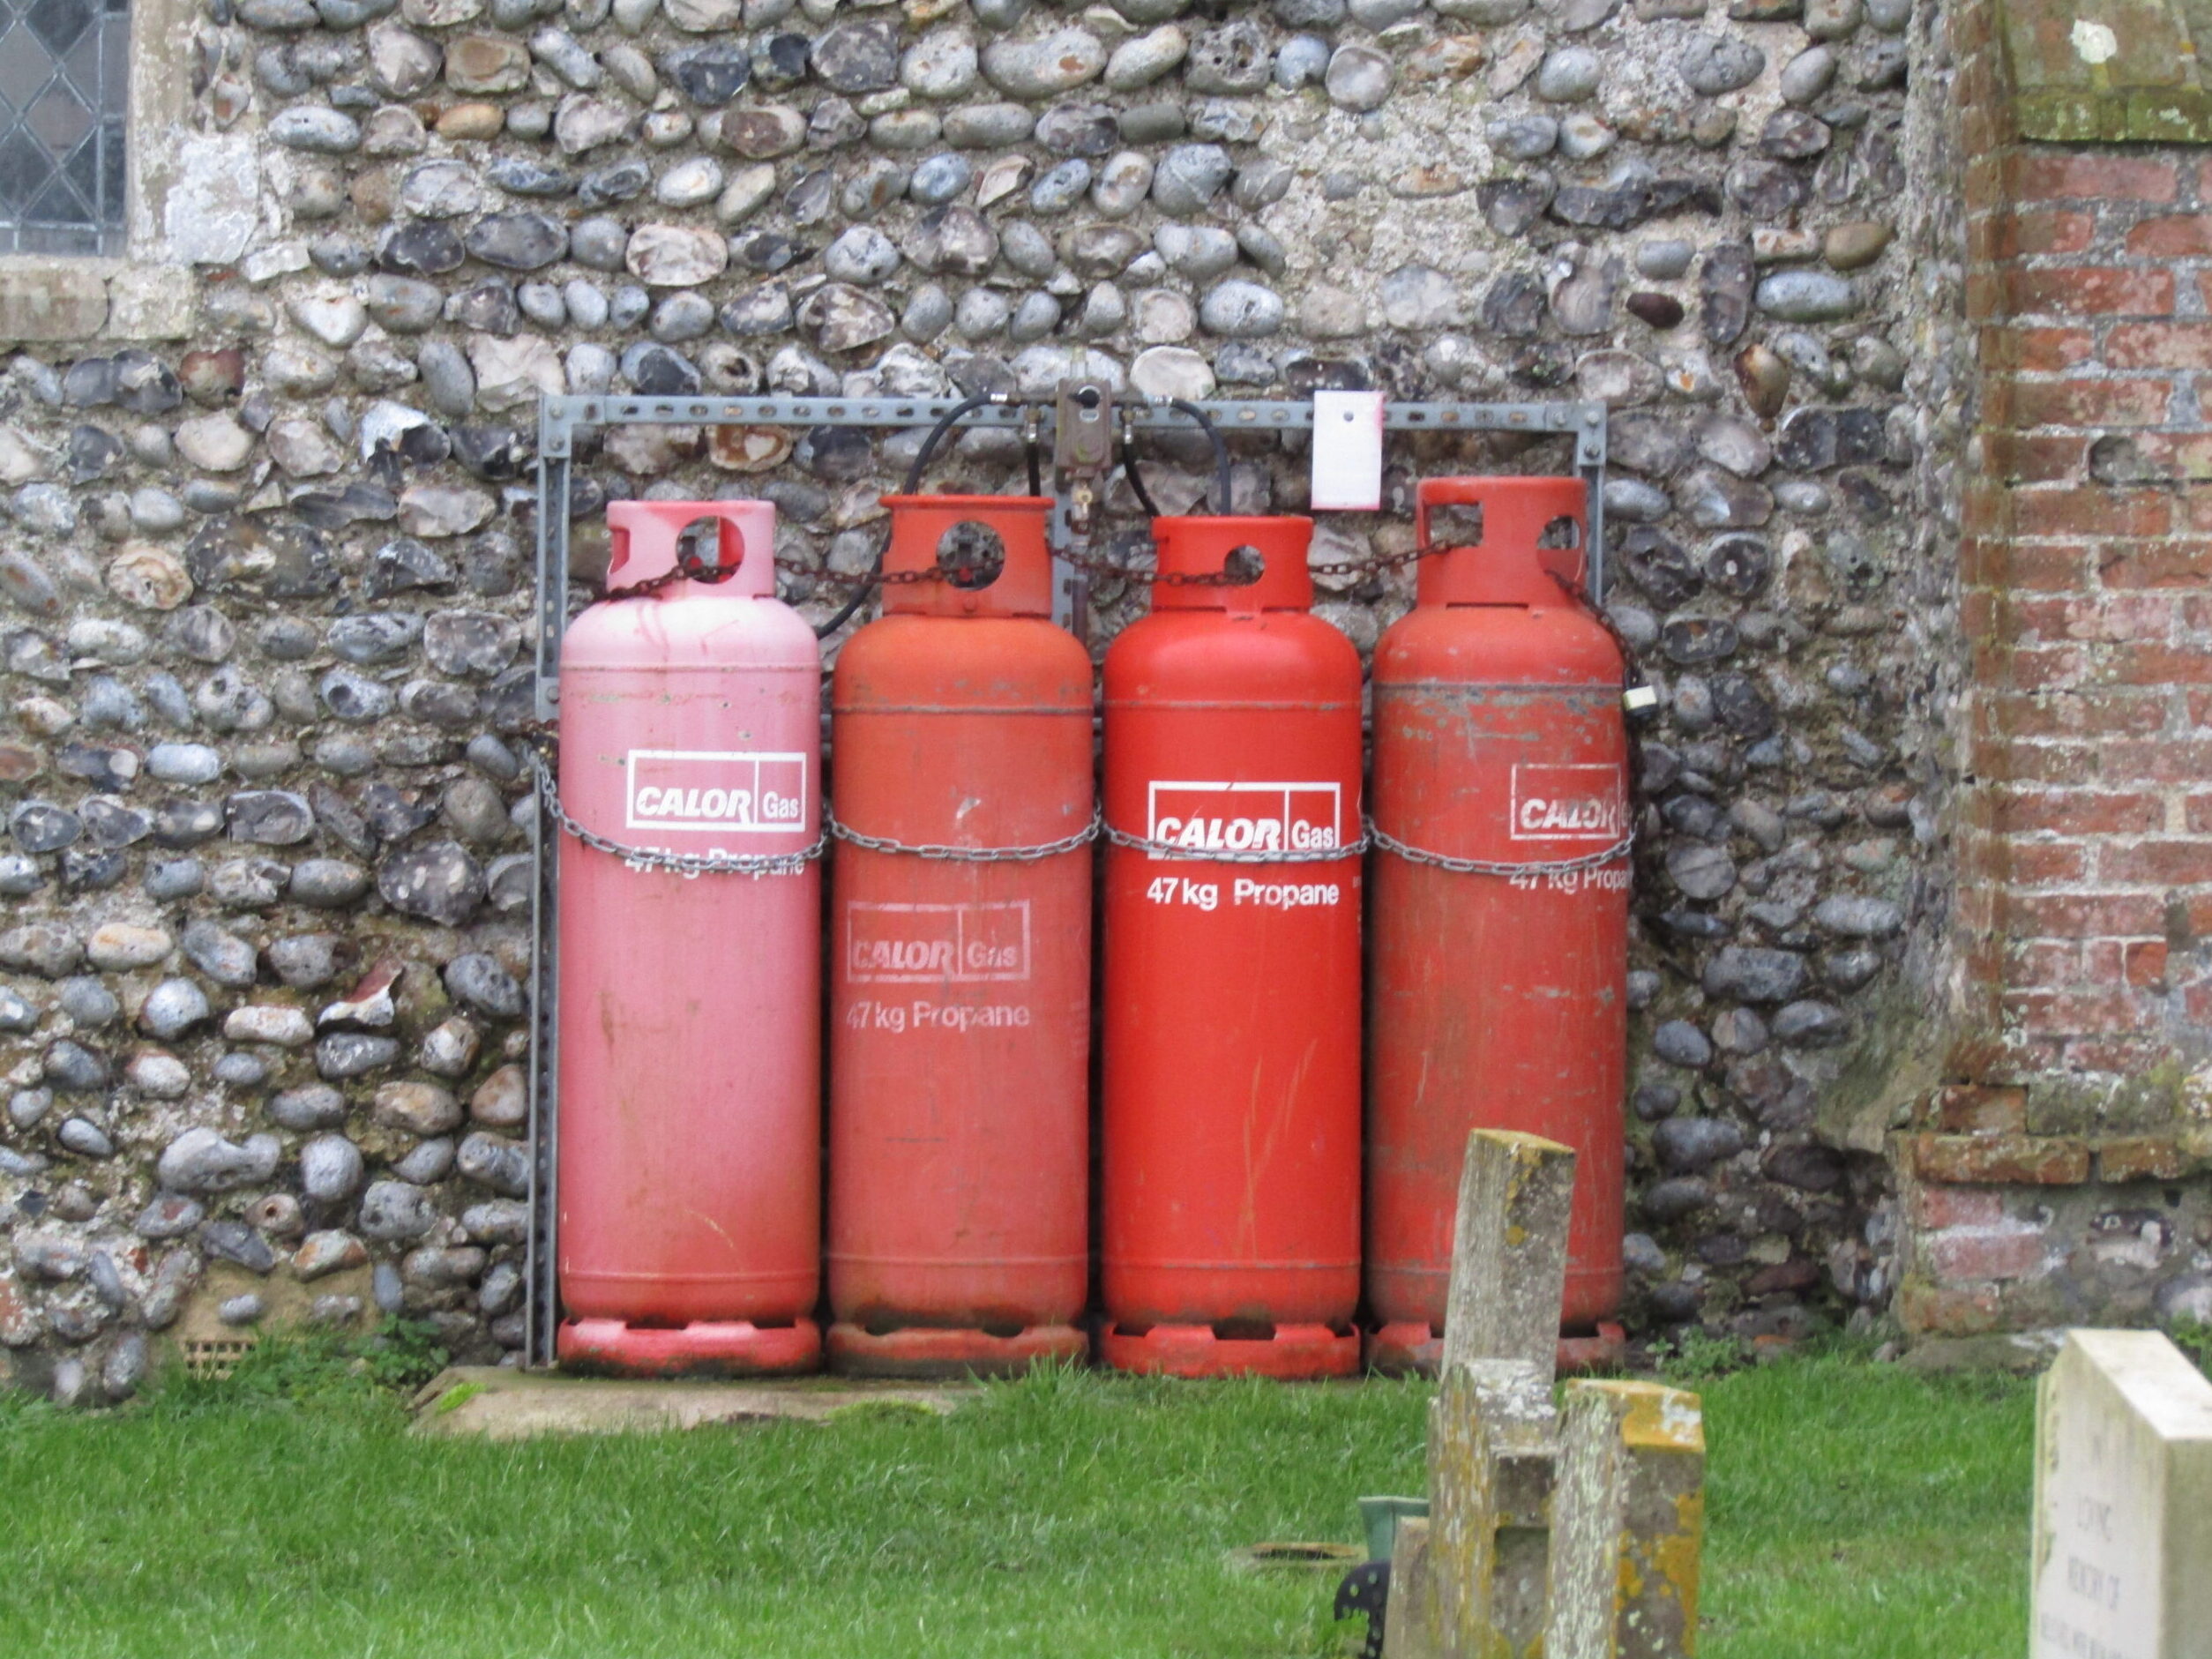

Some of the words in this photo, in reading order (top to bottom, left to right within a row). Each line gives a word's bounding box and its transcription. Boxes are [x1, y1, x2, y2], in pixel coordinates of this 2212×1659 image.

[636, 786, 751, 822] CALOR
[762, 791, 798, 819] Gas
[1155, 817, 1282, 849] CALOR
[1291, 819, 1334, 848] Gas
[1234, 878, 1340, 911] Propane
[852, 939, 955, 975] CALOR
[967, 942, 1017, 968] Gas
[913, 1000, 1030, 1033] Propane
